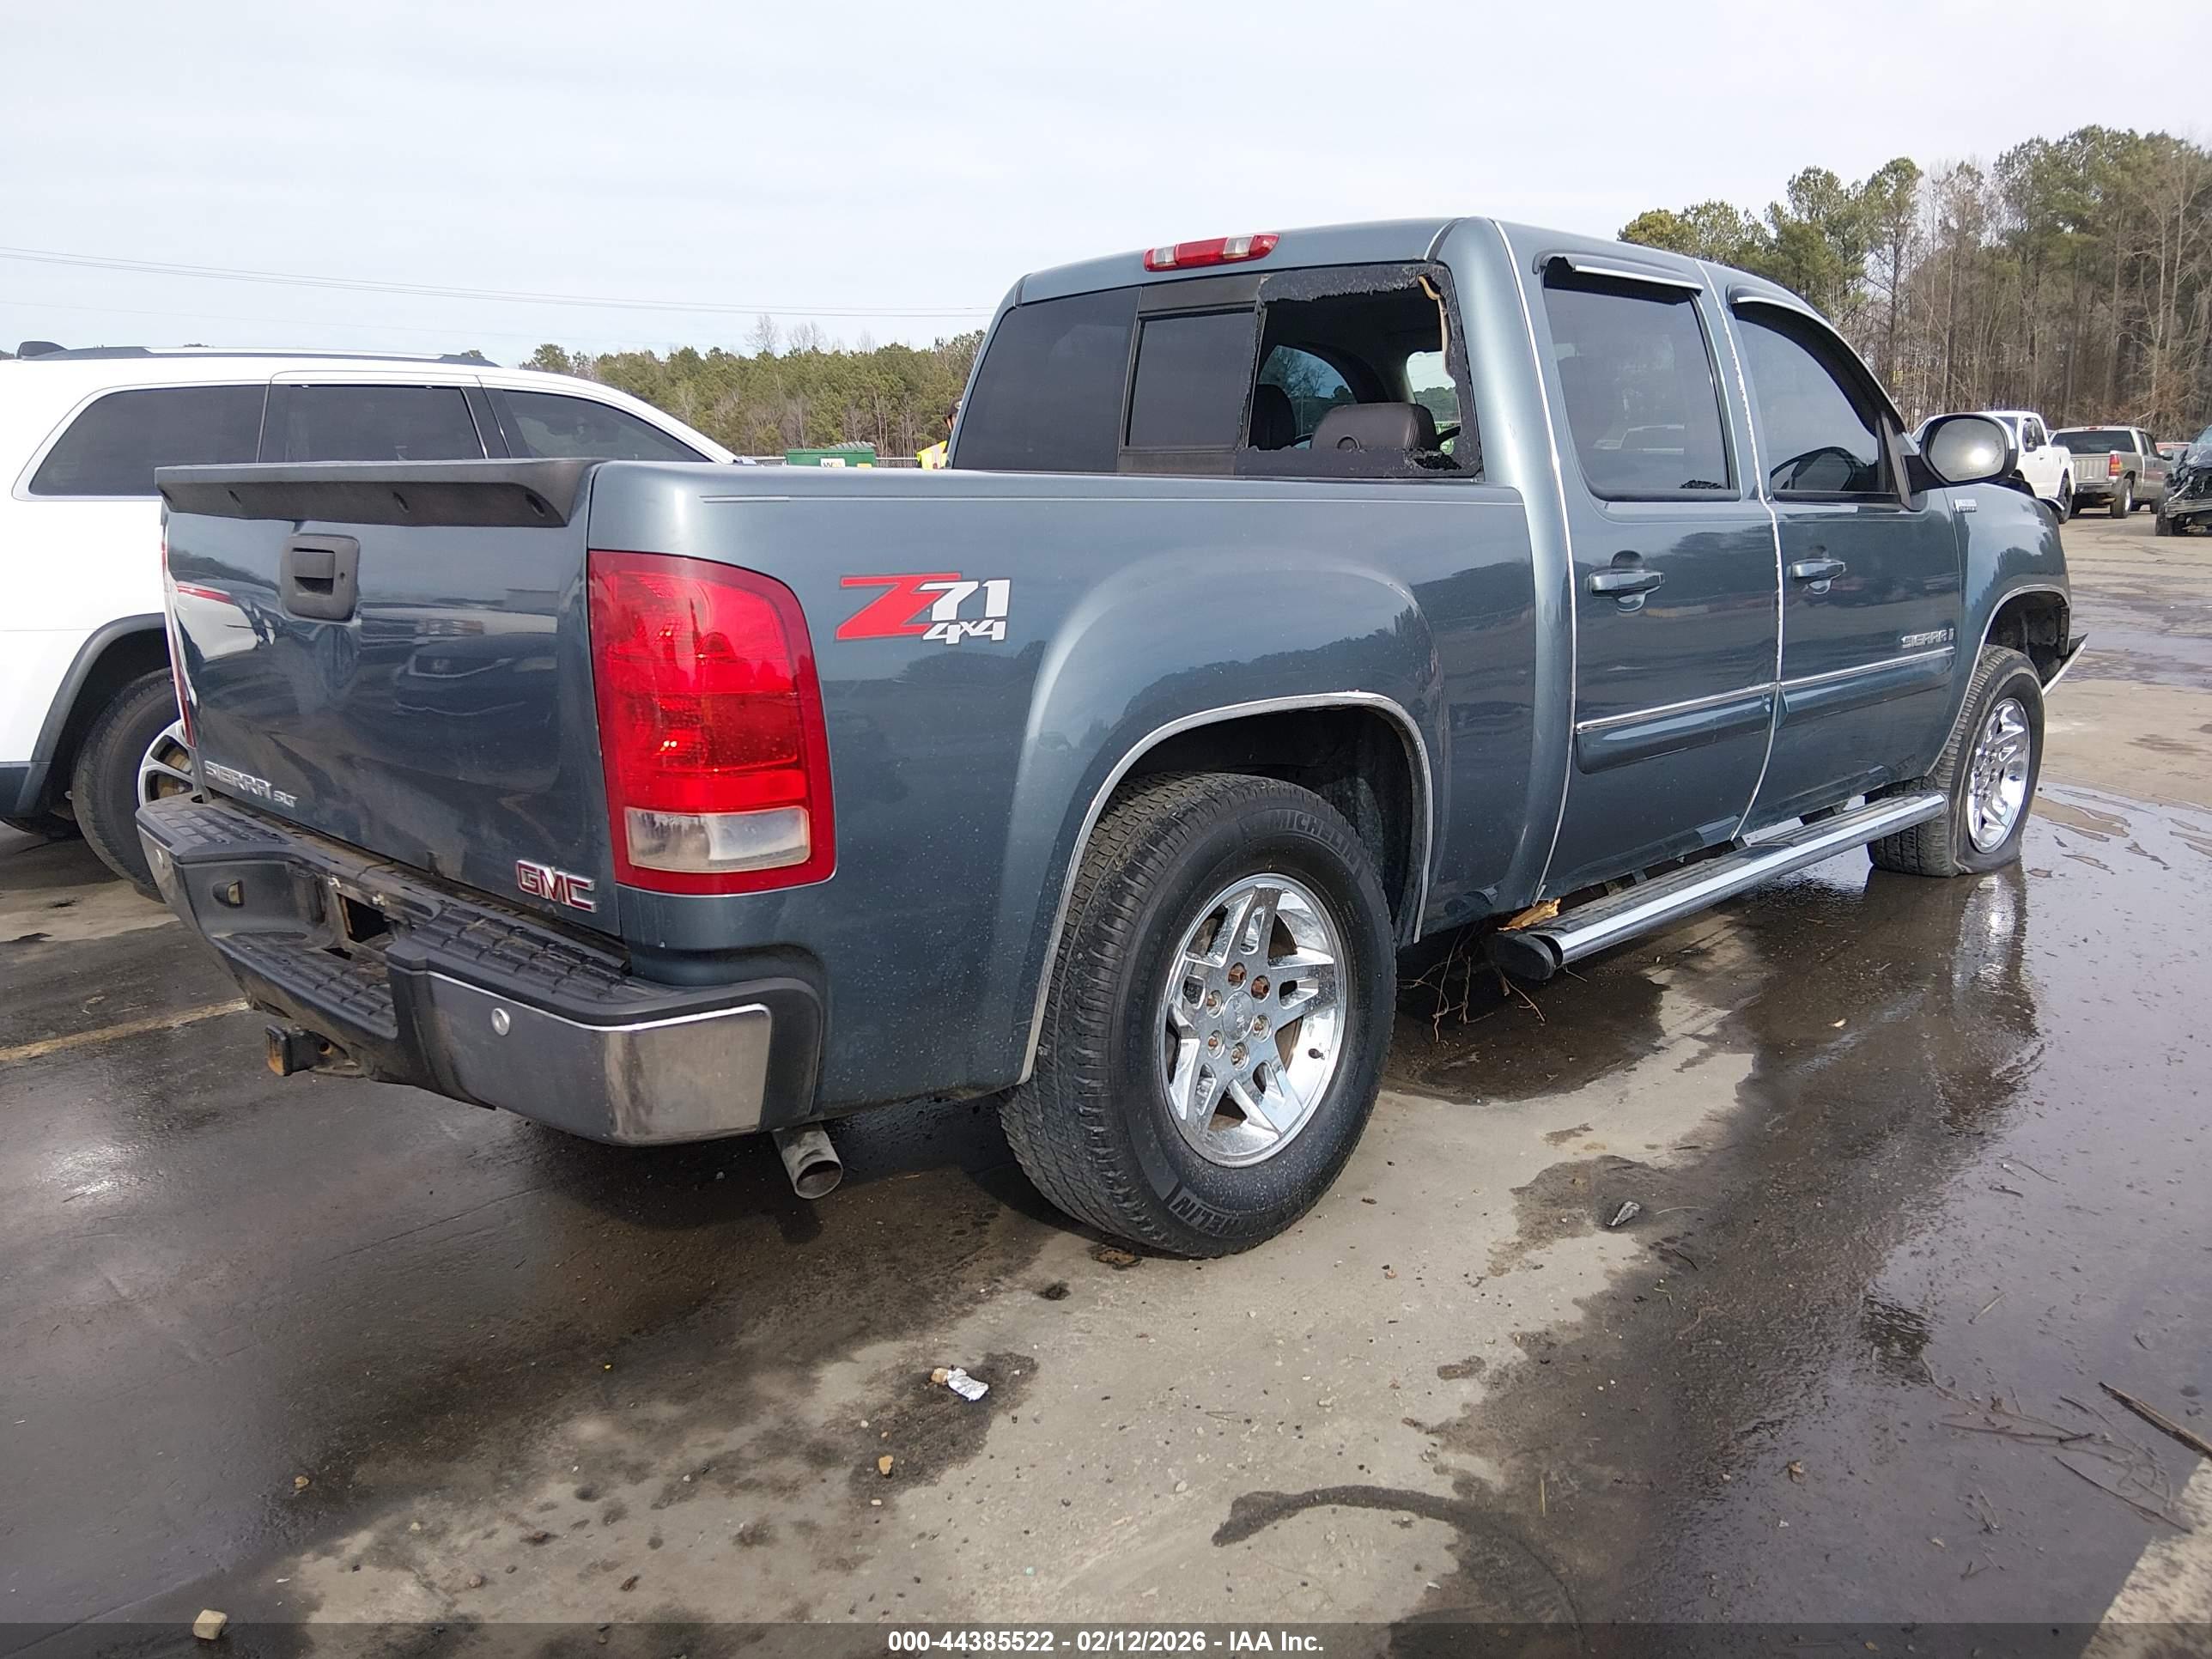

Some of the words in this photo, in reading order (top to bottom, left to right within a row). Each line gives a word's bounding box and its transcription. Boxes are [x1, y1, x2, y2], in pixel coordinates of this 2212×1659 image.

[836, 572, 1011, 640] Z71
[204, 759, 272, 799] SIERRA
[1268, 810, 1361, 874] MICHELIN
[516, 860, 597, 914] GMC
